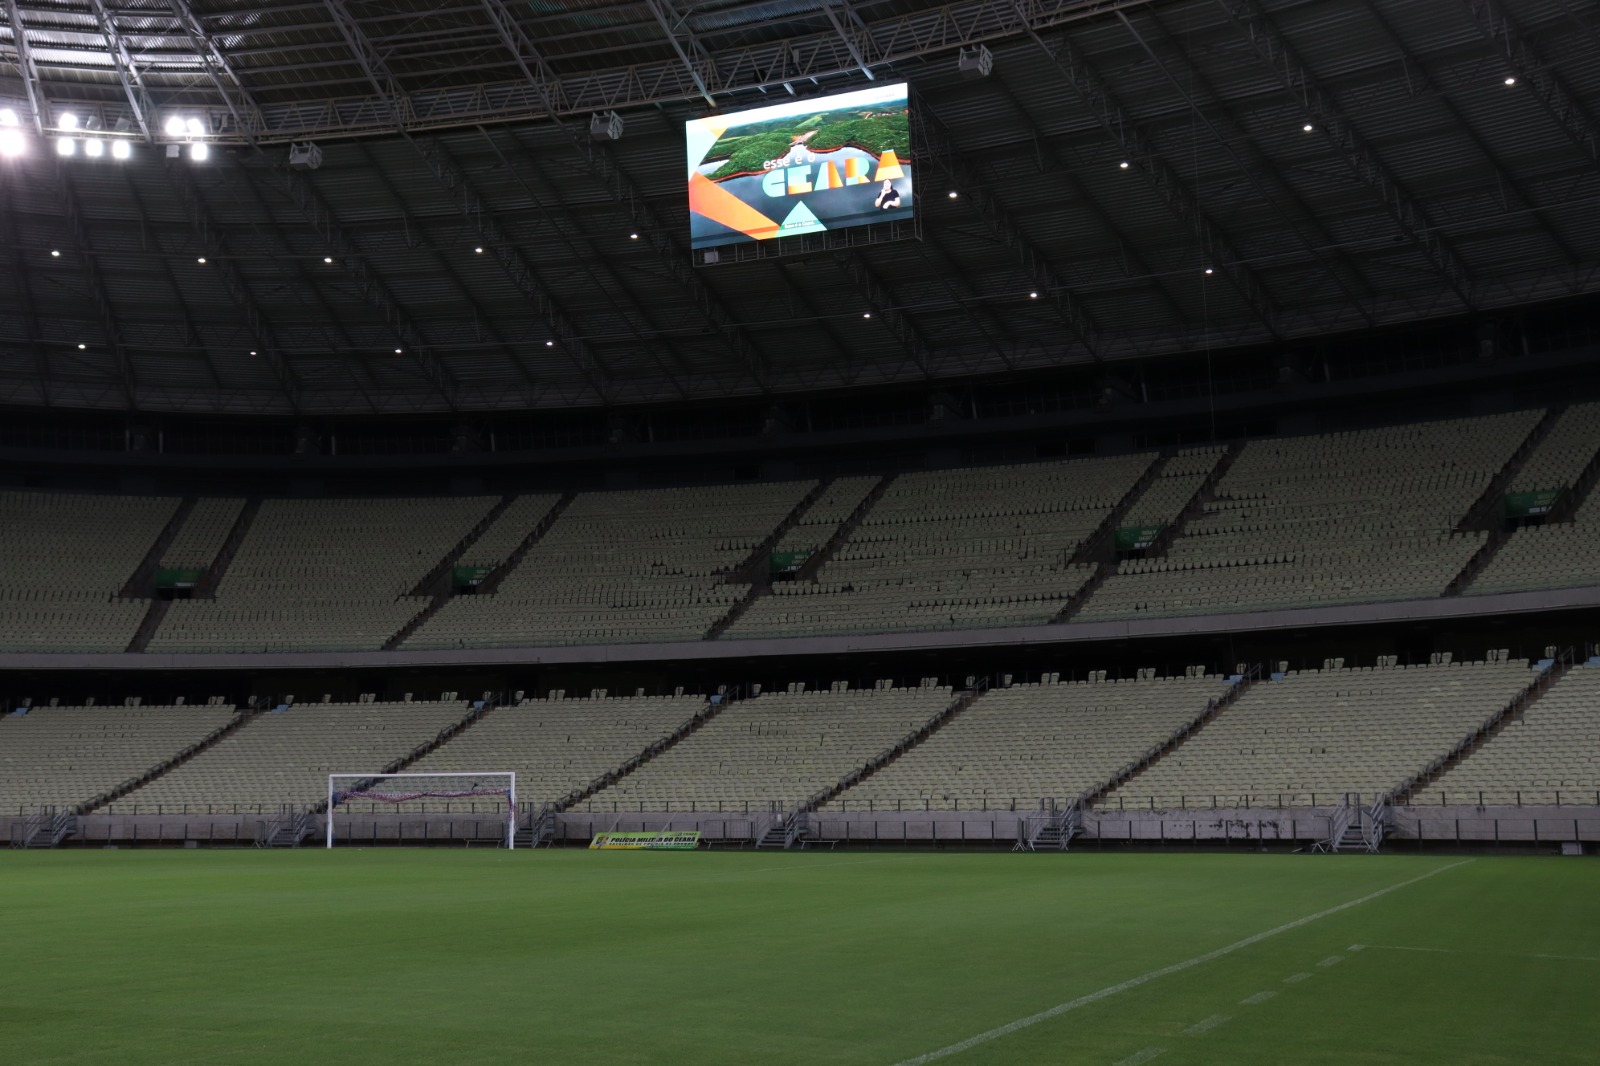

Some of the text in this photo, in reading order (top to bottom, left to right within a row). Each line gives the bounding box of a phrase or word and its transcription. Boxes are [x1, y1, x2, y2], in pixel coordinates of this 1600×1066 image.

[763, 153, 816, 170] esse é o
